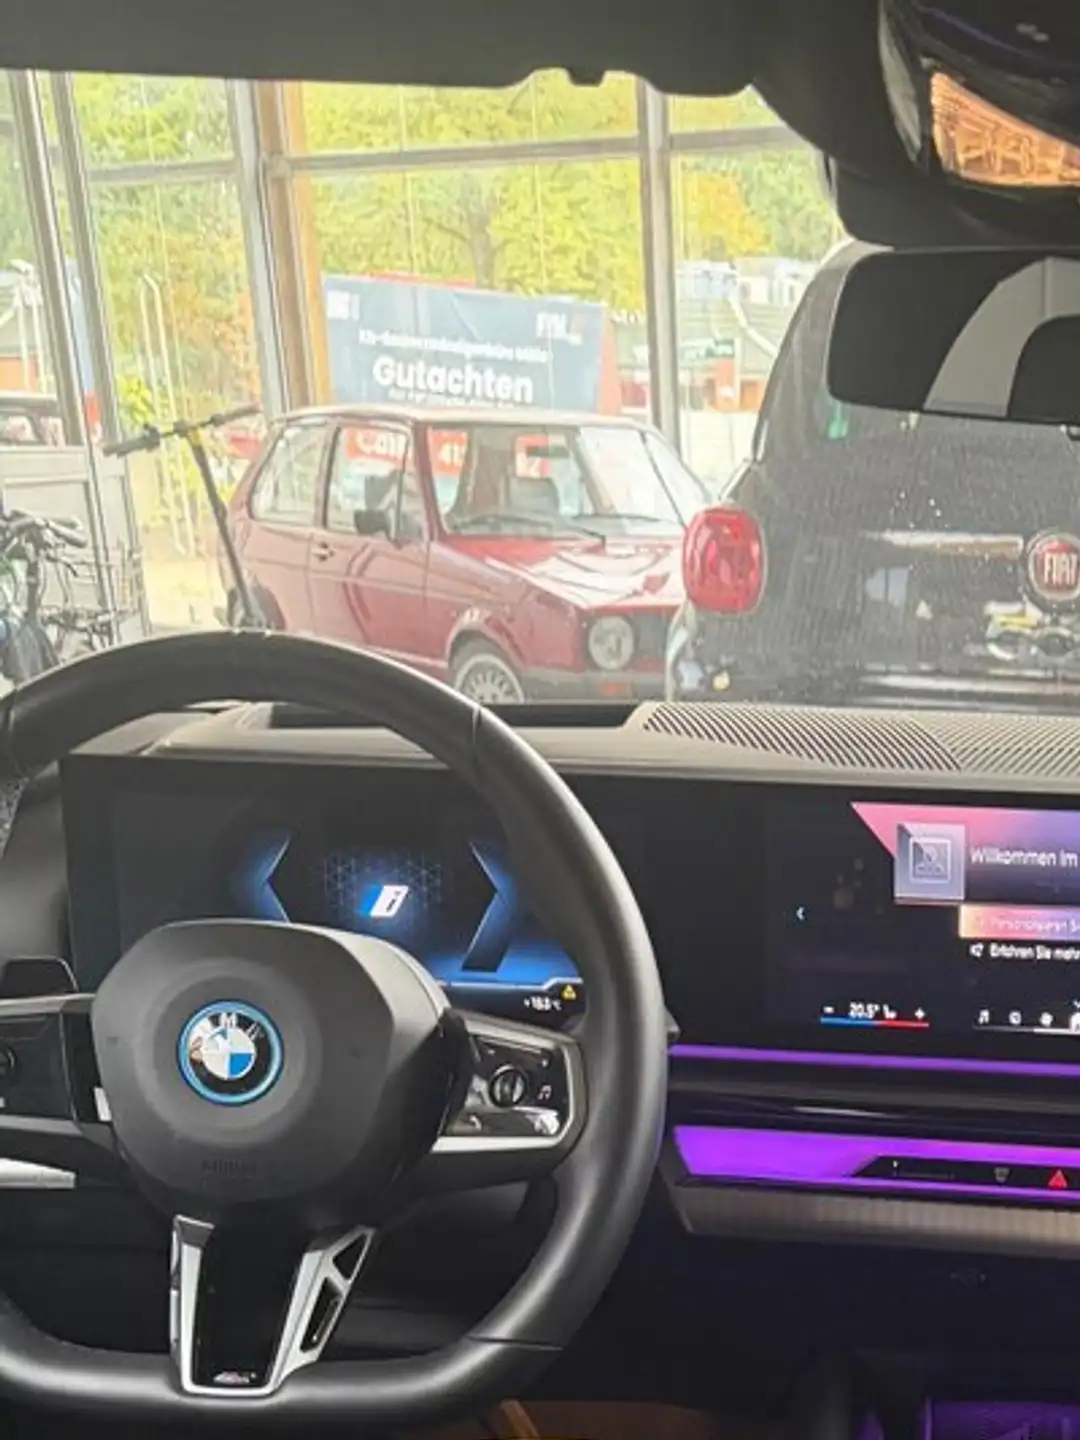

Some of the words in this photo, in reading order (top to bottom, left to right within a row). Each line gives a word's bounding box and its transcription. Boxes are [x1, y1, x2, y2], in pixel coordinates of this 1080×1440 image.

[372, 356, 533, 402] Gutachten
[1044, 552, 1078, 585] FIAT
[971, 846, 1056, 866] Willkommen
[1060, 849, 1078, 868] im
